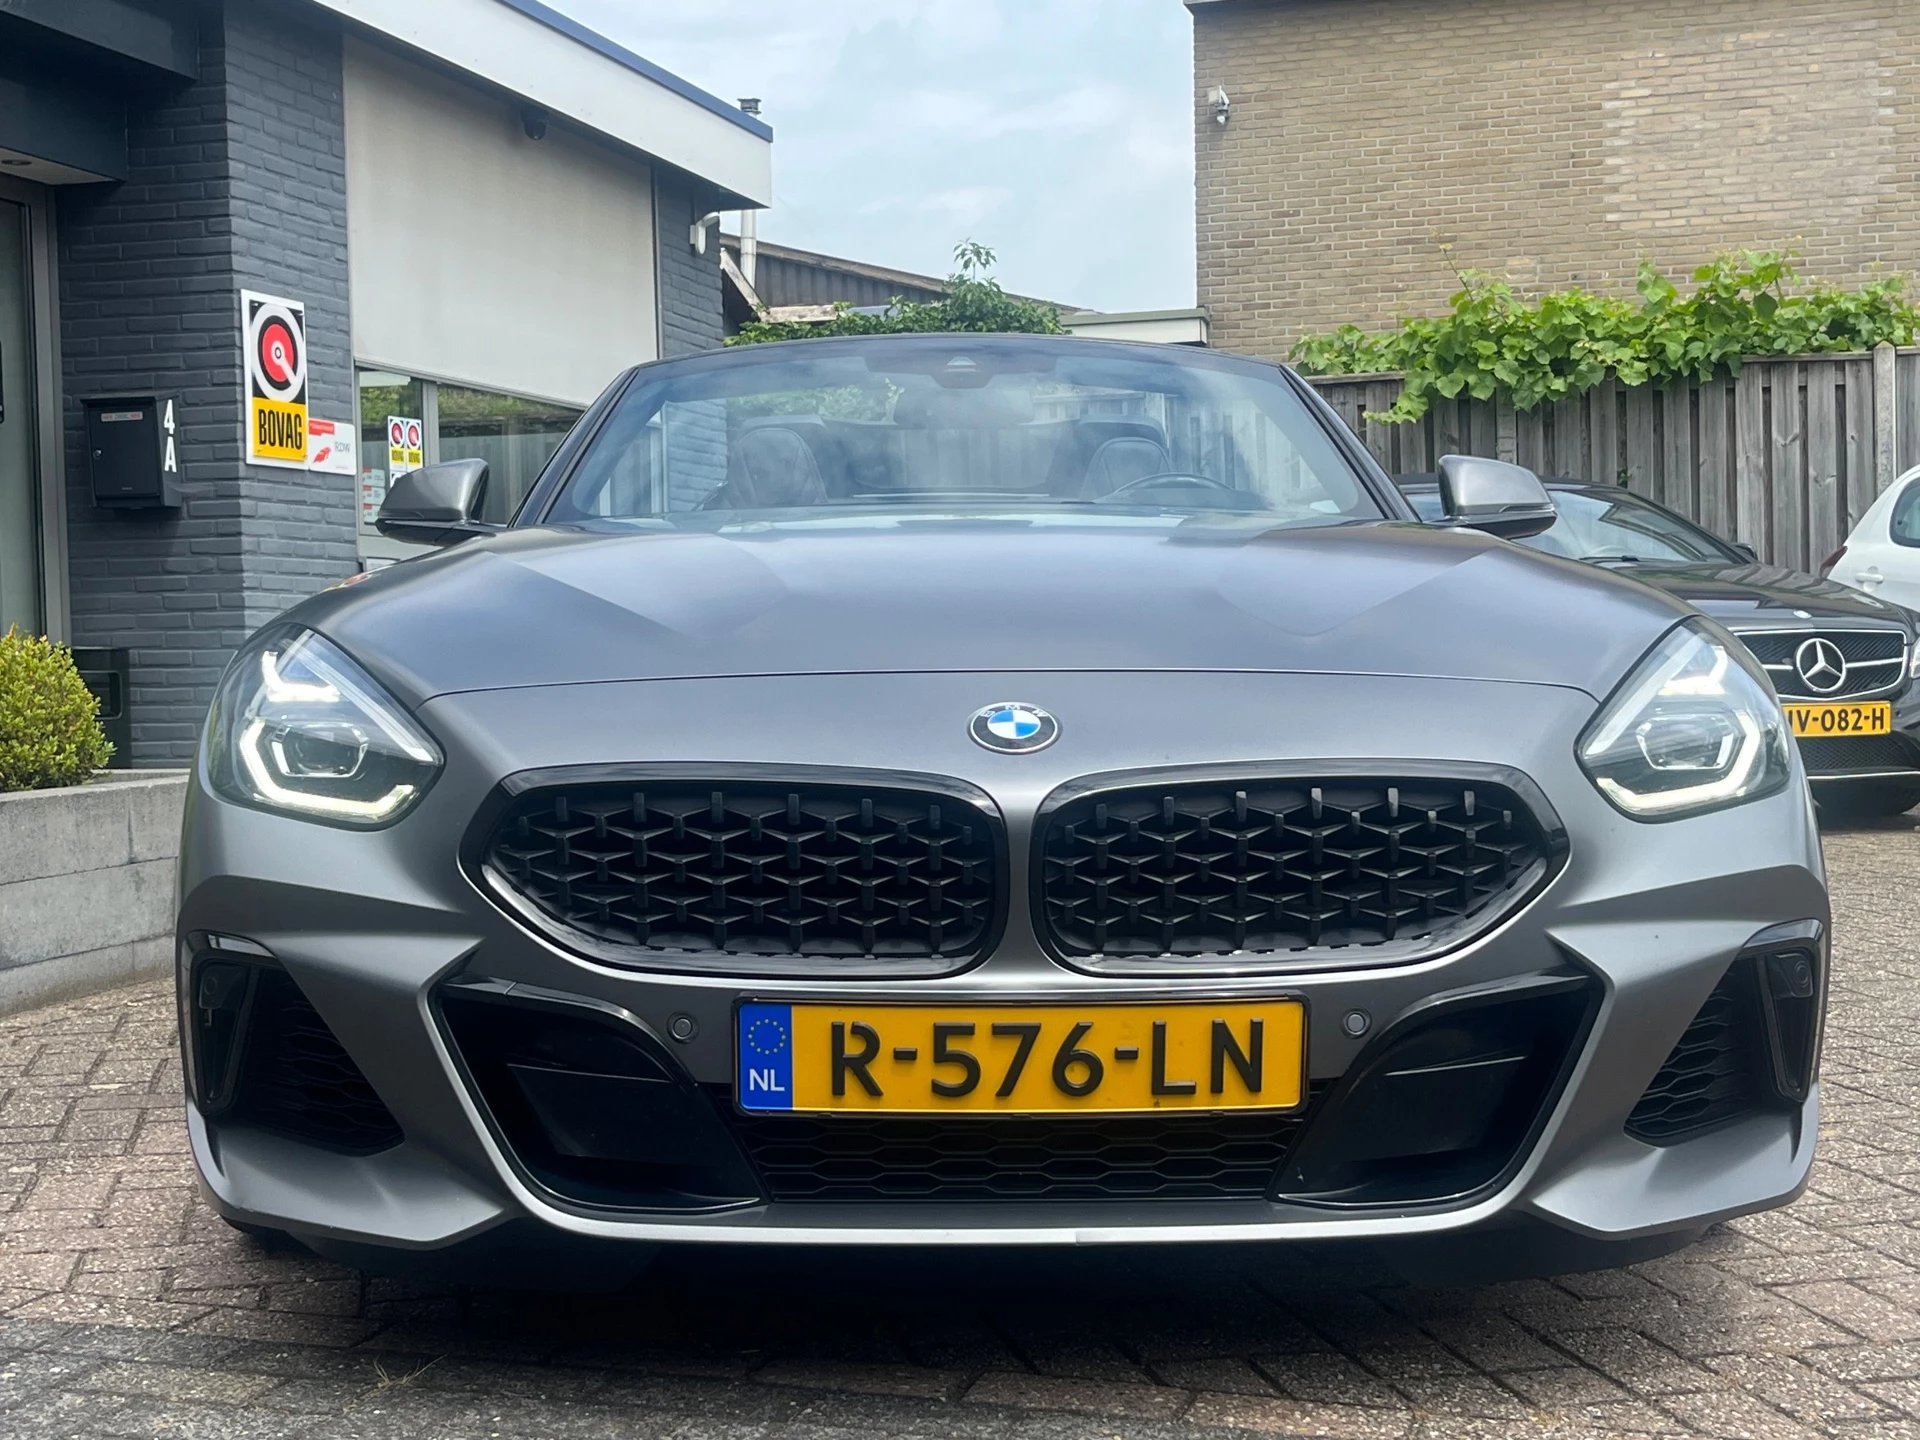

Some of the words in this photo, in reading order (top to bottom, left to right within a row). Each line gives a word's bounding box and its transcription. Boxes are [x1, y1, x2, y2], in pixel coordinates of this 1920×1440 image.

[258, 408, 302, 450] BOVAG
[830, 1018, 1264, 1098] R-576-LN
[749, 1068, 785, 1092] NL
